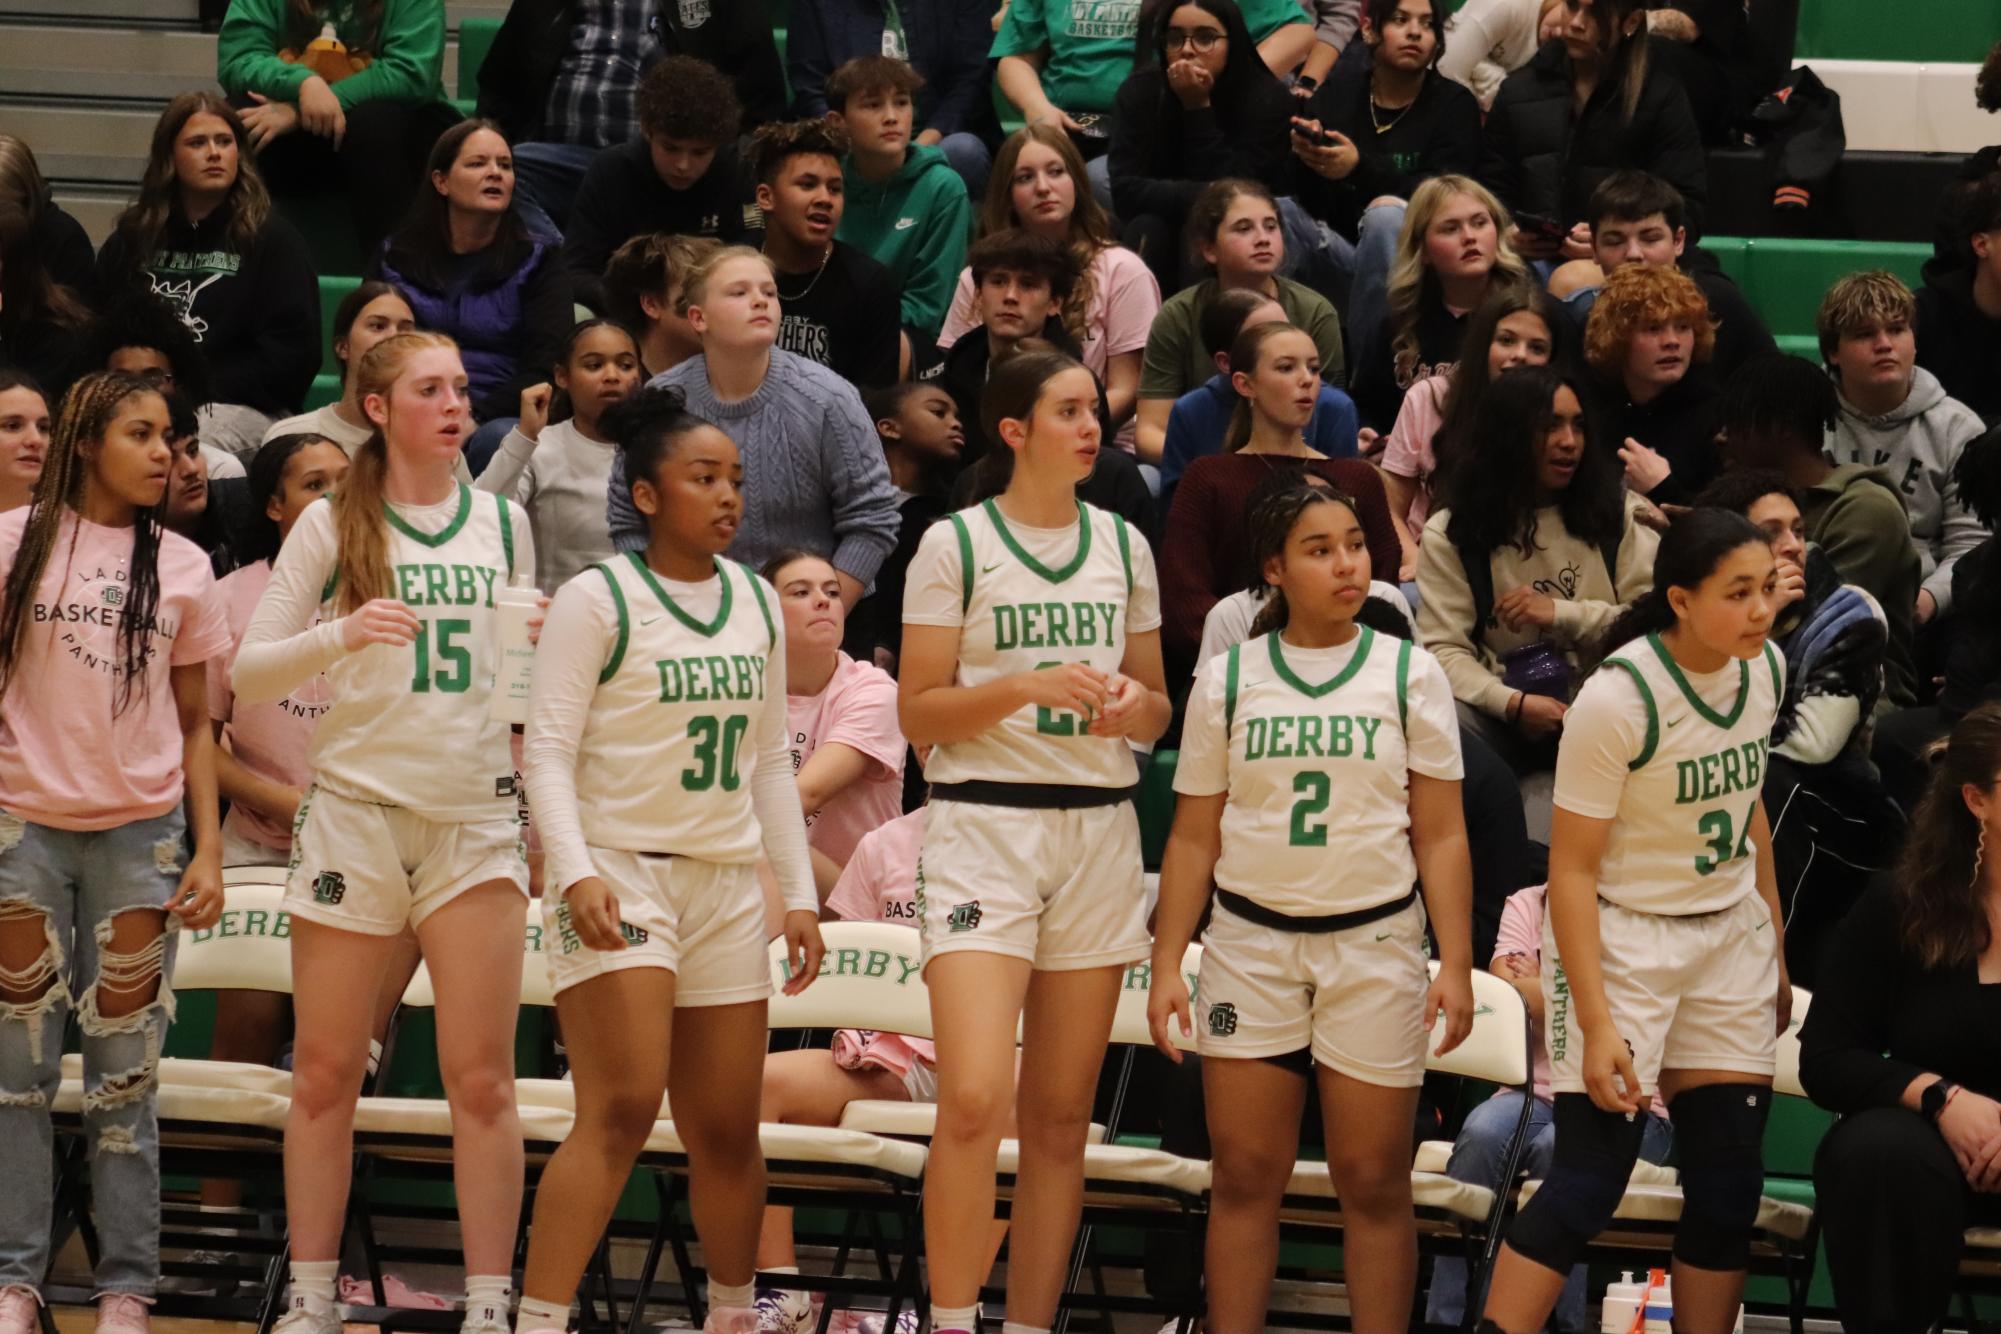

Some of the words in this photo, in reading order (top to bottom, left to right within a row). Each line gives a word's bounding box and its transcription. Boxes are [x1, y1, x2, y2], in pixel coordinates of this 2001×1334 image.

[79, 567, 128, 583] LAD
[396, 563, 497, 608] ERBY
[992, 602, 1117, 651] DERBY
[411, 618, 472, 693] 15
[655, 654, 765, 703] DERBY
[681, 714, 749, 792] 30
[1244, 715, 1382, 762] DERBY
[1288, 770, 1332, 847] 2
[191, 910, 294, 944] DERB
